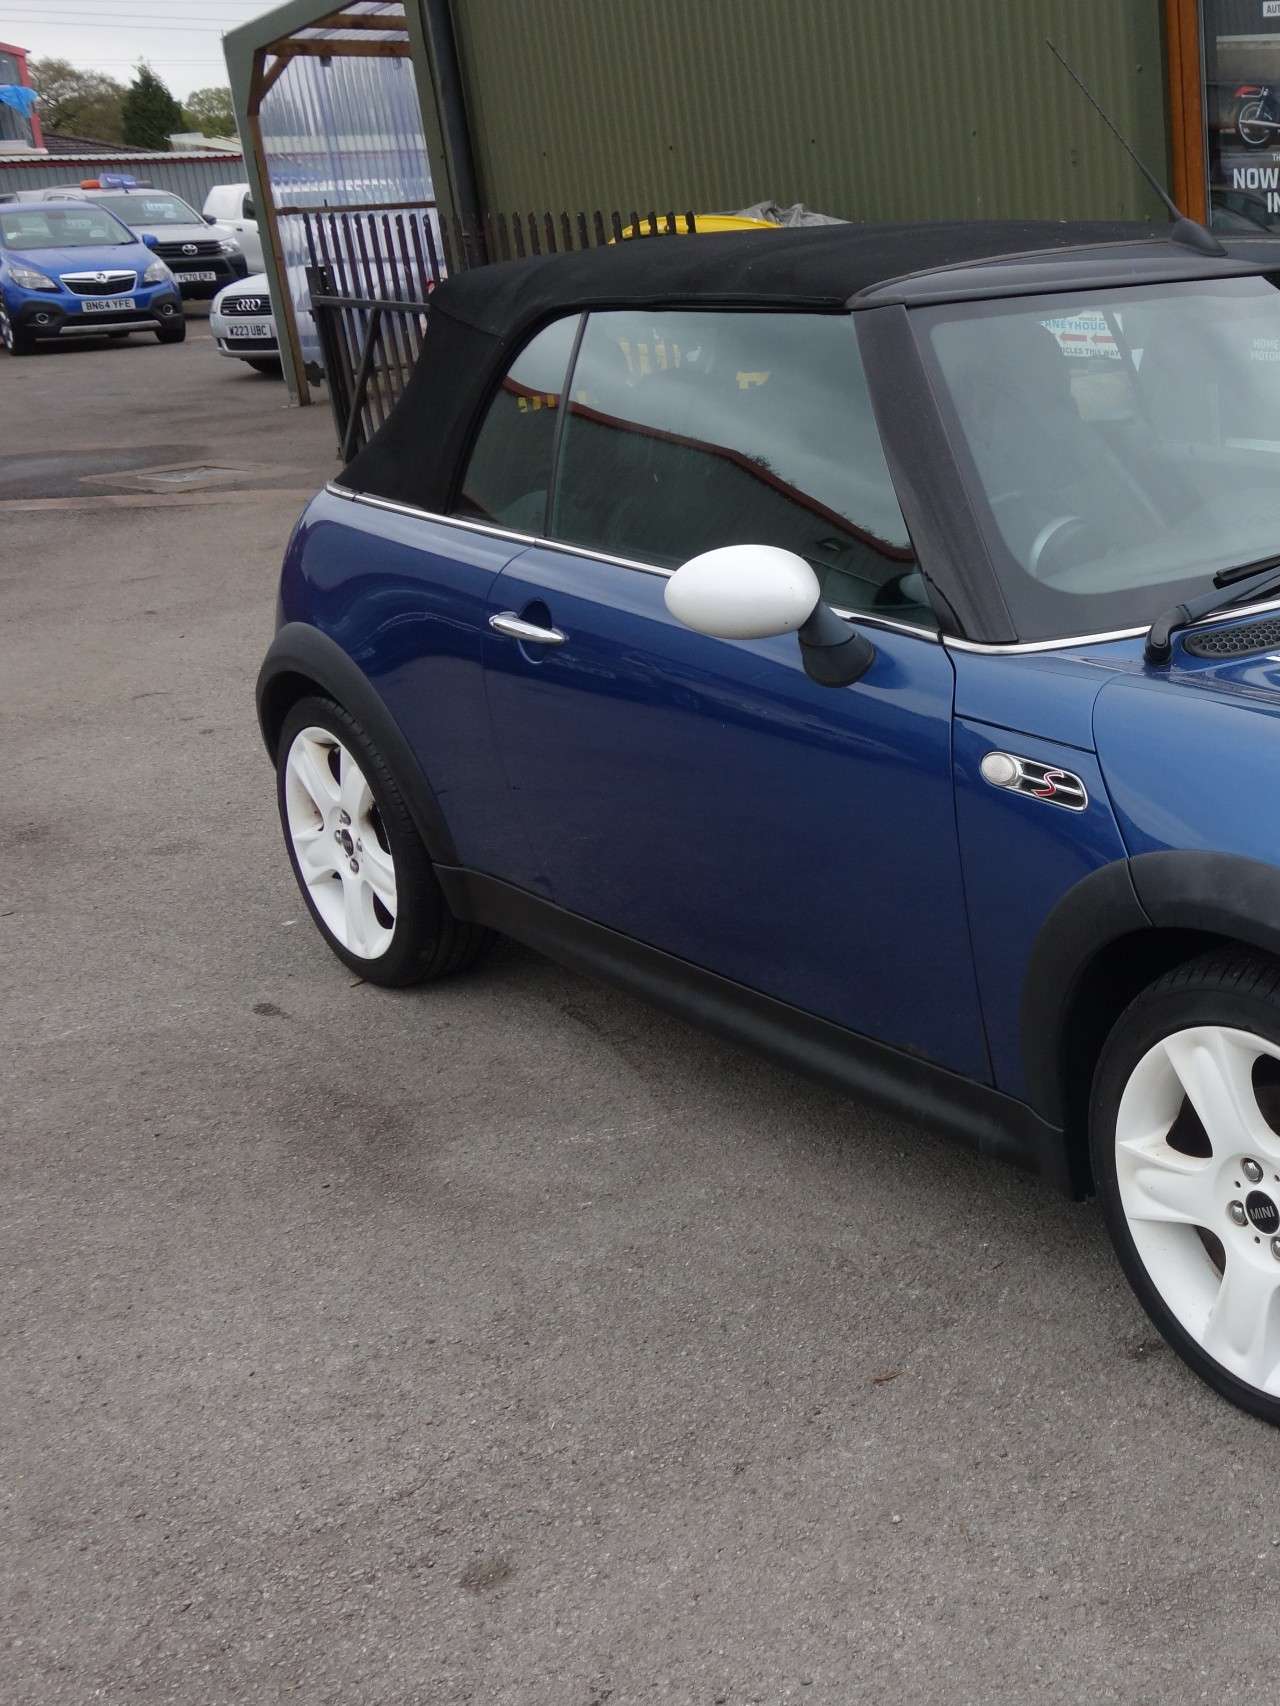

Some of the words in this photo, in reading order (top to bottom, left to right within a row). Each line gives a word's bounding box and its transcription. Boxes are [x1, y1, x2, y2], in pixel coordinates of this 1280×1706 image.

[1233, 168, 1278, 189] NOW
[85, 301, 111, 310] BN64
[113, 300, 131, 308] YFE
[1250, 1205, 1275, 1220] MINI
